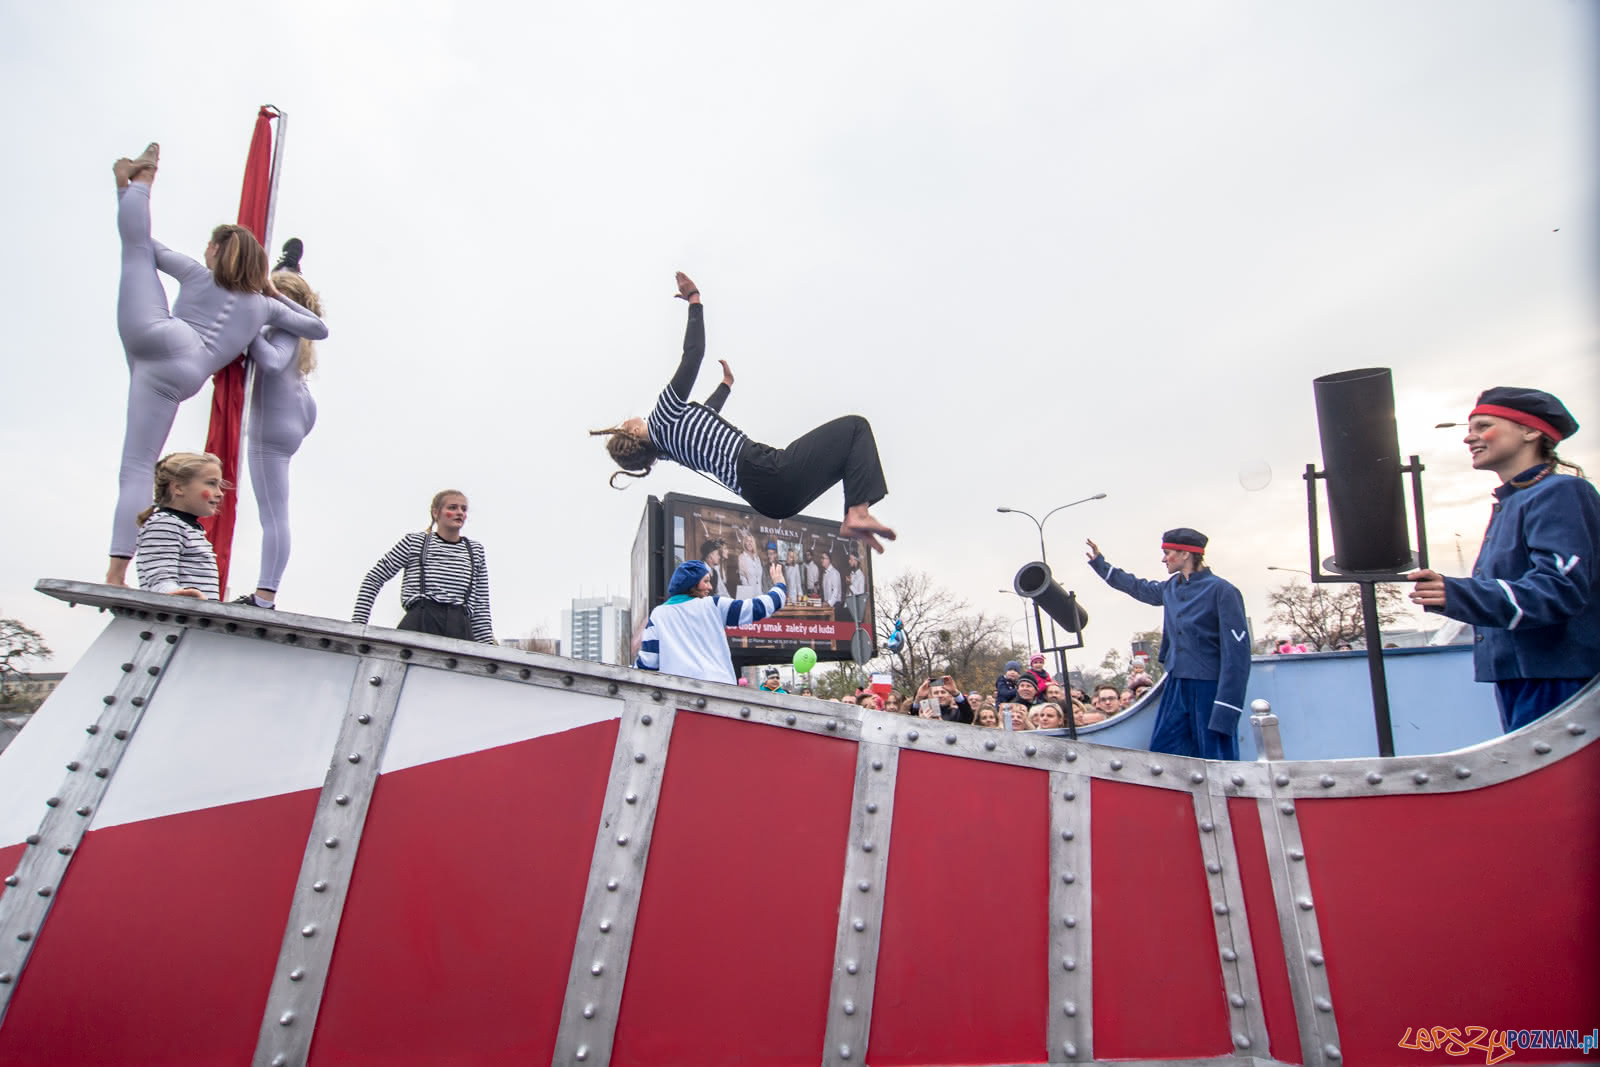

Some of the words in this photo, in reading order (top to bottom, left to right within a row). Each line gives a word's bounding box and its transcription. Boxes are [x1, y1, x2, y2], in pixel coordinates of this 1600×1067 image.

[760, 526, 799, 538] BROWARNA
[763, 622, 782, 632] smak
[786, 623, 807, 635] zależy
[809, 624, 817, 633] od
[819, 624, 835, 634] ludzi
